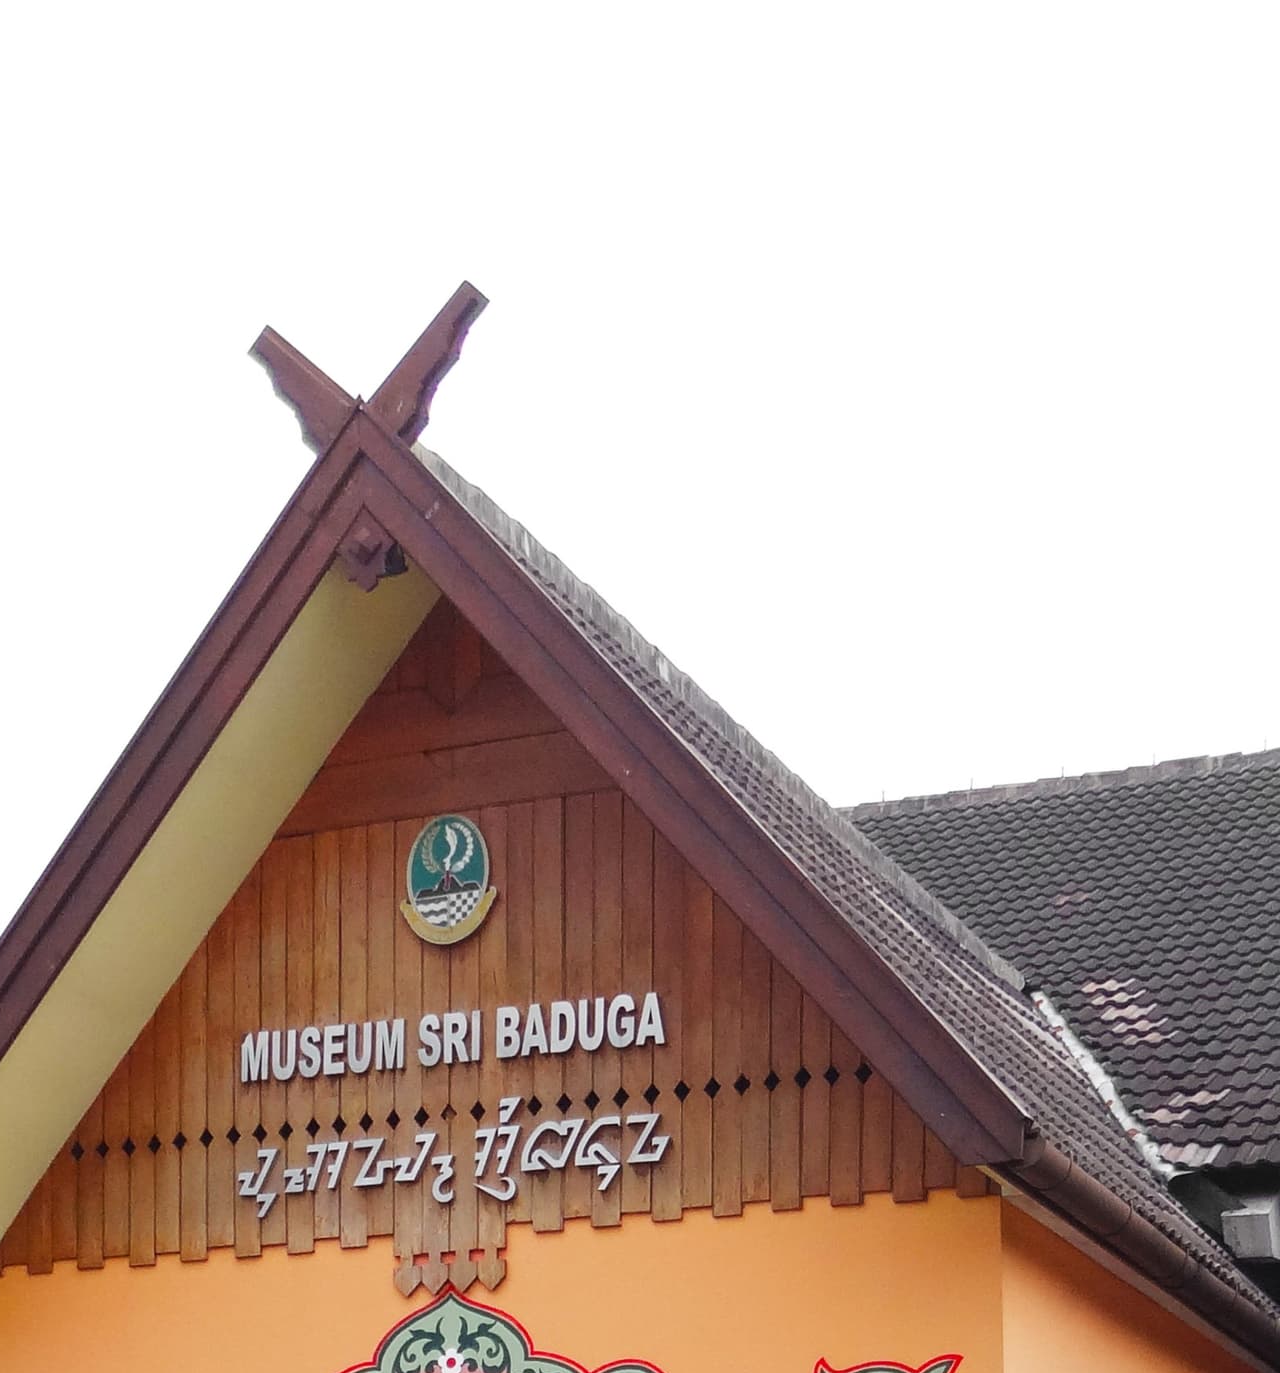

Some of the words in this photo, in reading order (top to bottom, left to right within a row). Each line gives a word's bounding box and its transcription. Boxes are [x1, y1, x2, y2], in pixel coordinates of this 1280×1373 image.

[241, 1018, 406, 1082] MUSEUM
[417, 1010, 481, 1067] SRI
[495, 992, 666, 1060] BADUGA
